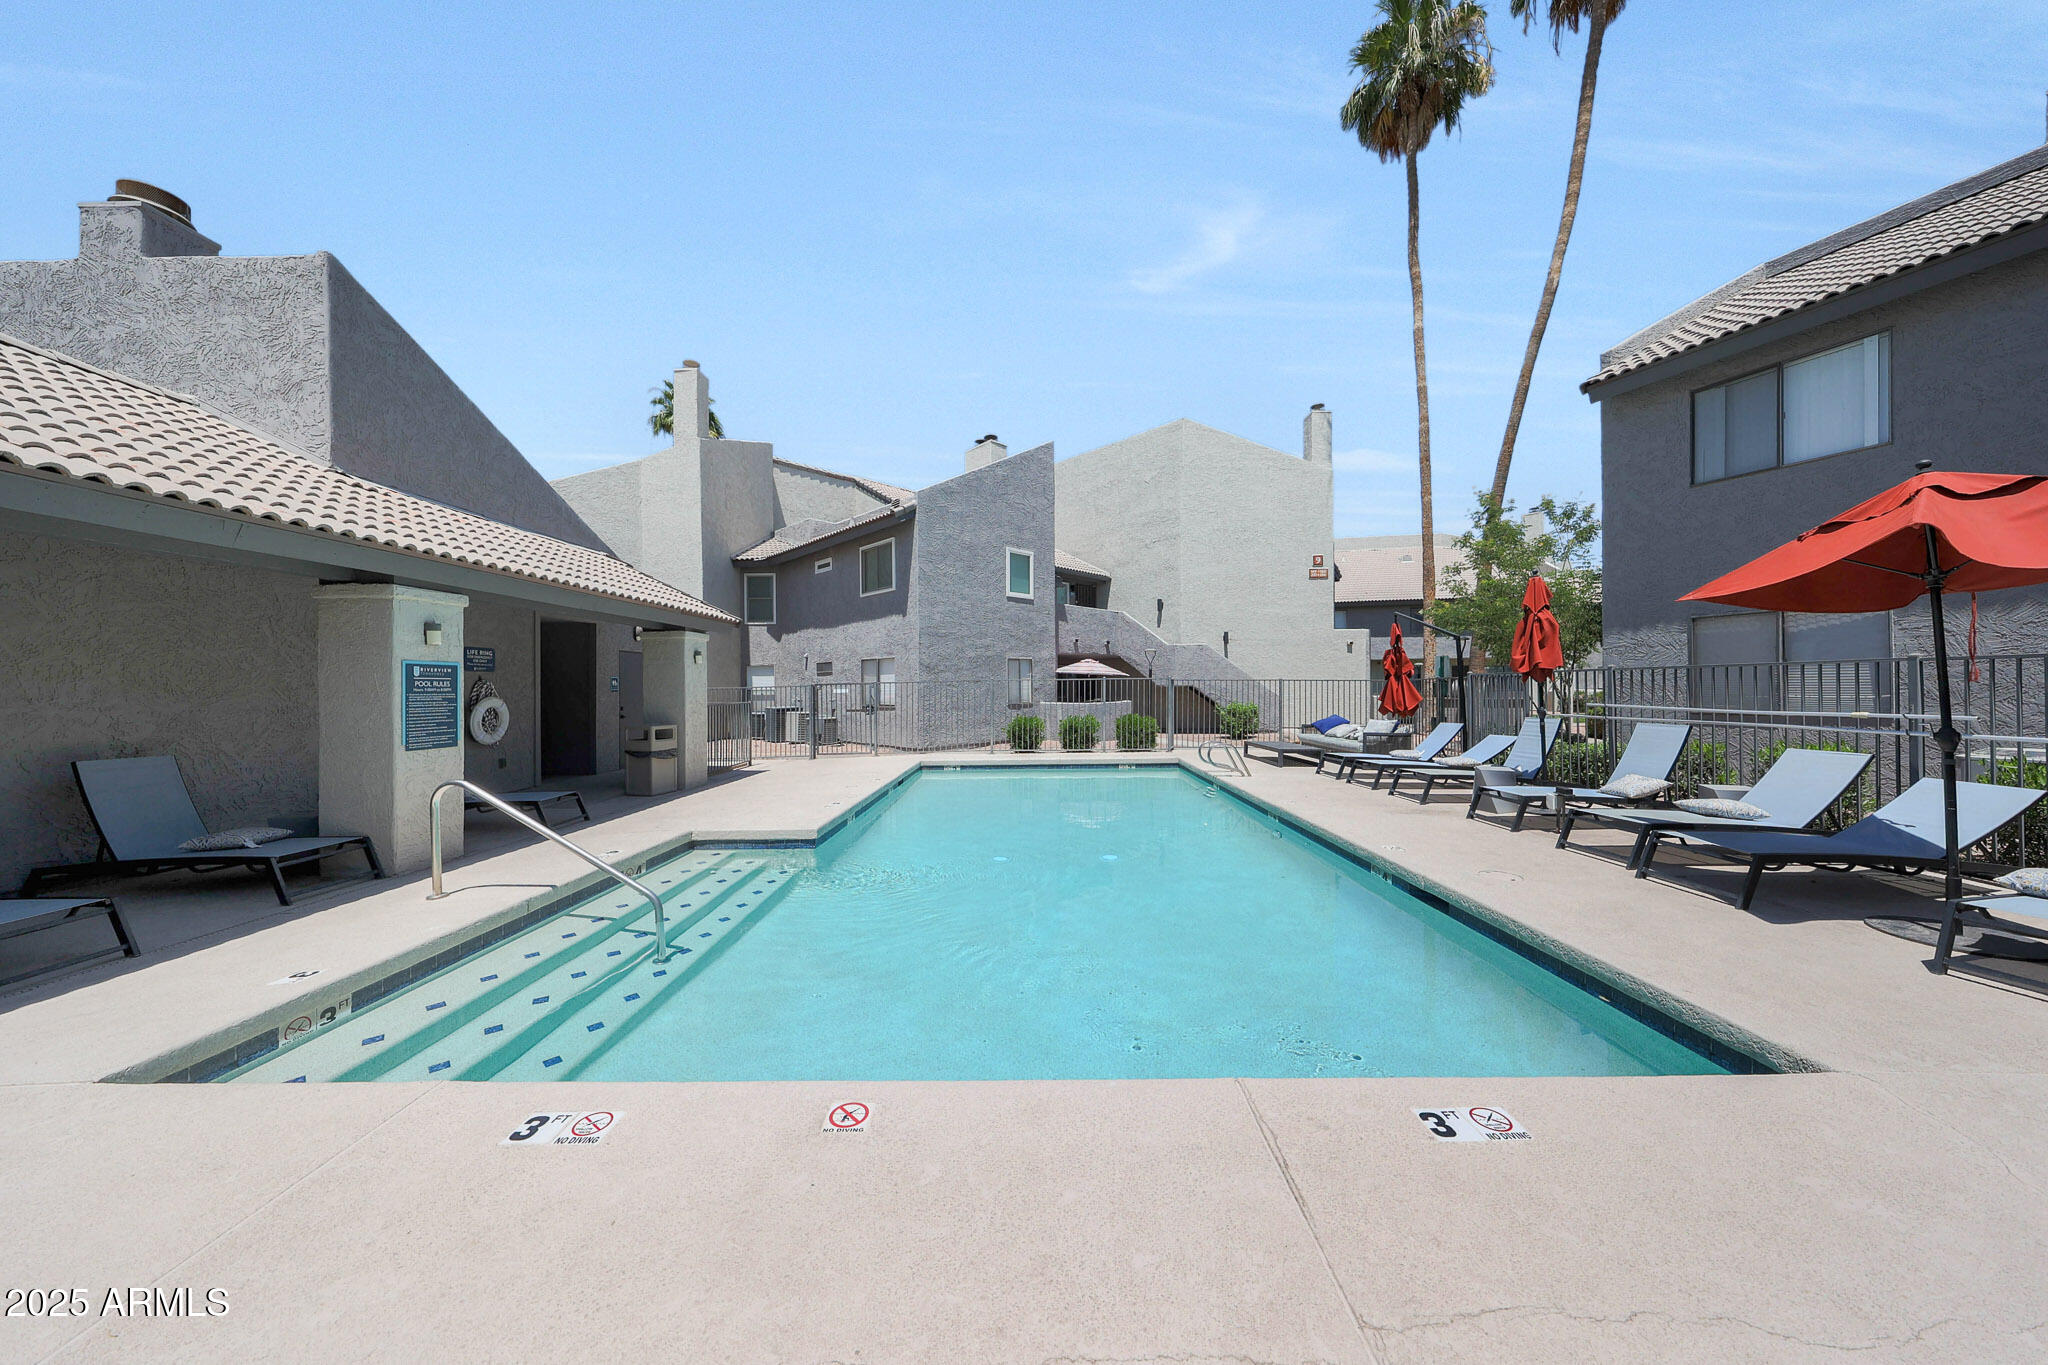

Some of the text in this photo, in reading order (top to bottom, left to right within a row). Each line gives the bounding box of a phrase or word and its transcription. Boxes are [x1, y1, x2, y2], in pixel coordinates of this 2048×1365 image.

[1315, 556, 1321, 564] 9
[320, 998, 351, 1026] 3 FT
[509, 1114, 573, 1141] 3 FT
[1419, 1111, 1460, 1138] 3 FT
[568, 1136, 600, 1144] DIVING
[1485, 1131, 1532, 1141] NO DIVING
